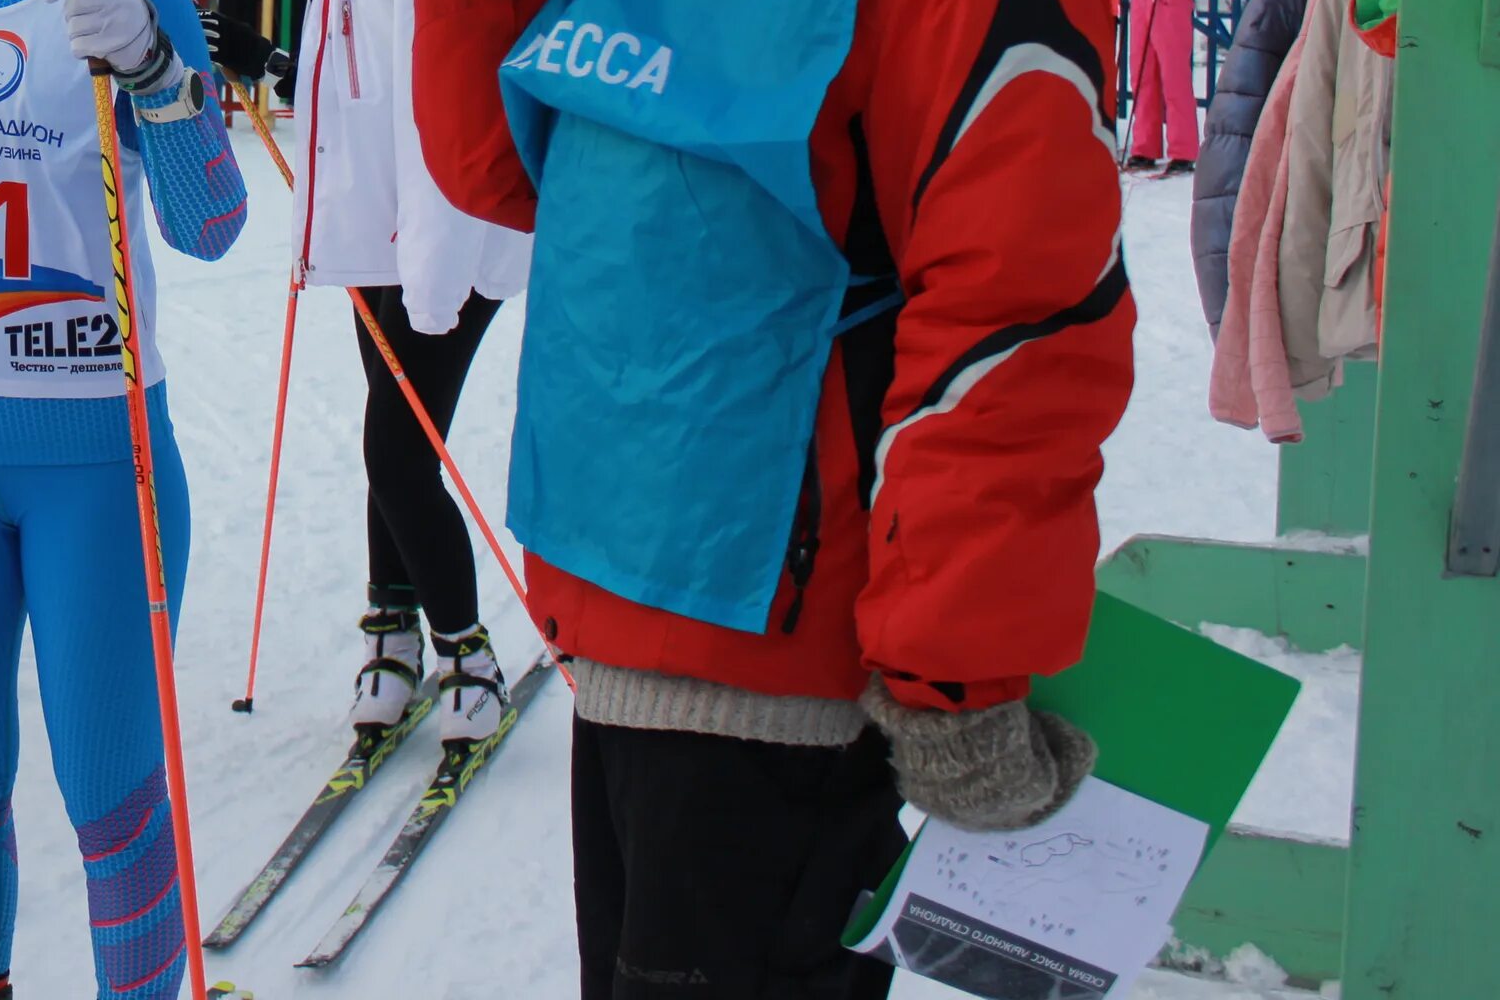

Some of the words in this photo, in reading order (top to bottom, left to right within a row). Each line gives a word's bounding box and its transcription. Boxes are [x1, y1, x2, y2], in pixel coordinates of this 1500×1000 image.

[4, 313, 122, 357] TELE2
[10, 361, 55, 373] Честно
[70, 362, 124, 374] дешевле
[908, 903, 970, 935] СТАДИОНА
[971, 929, 1030, 958] ЛЫЖНОГО
[1030, 951, 1067, 973] ТРАСС
[1068, 968, 1106, 988] СХЕМА
